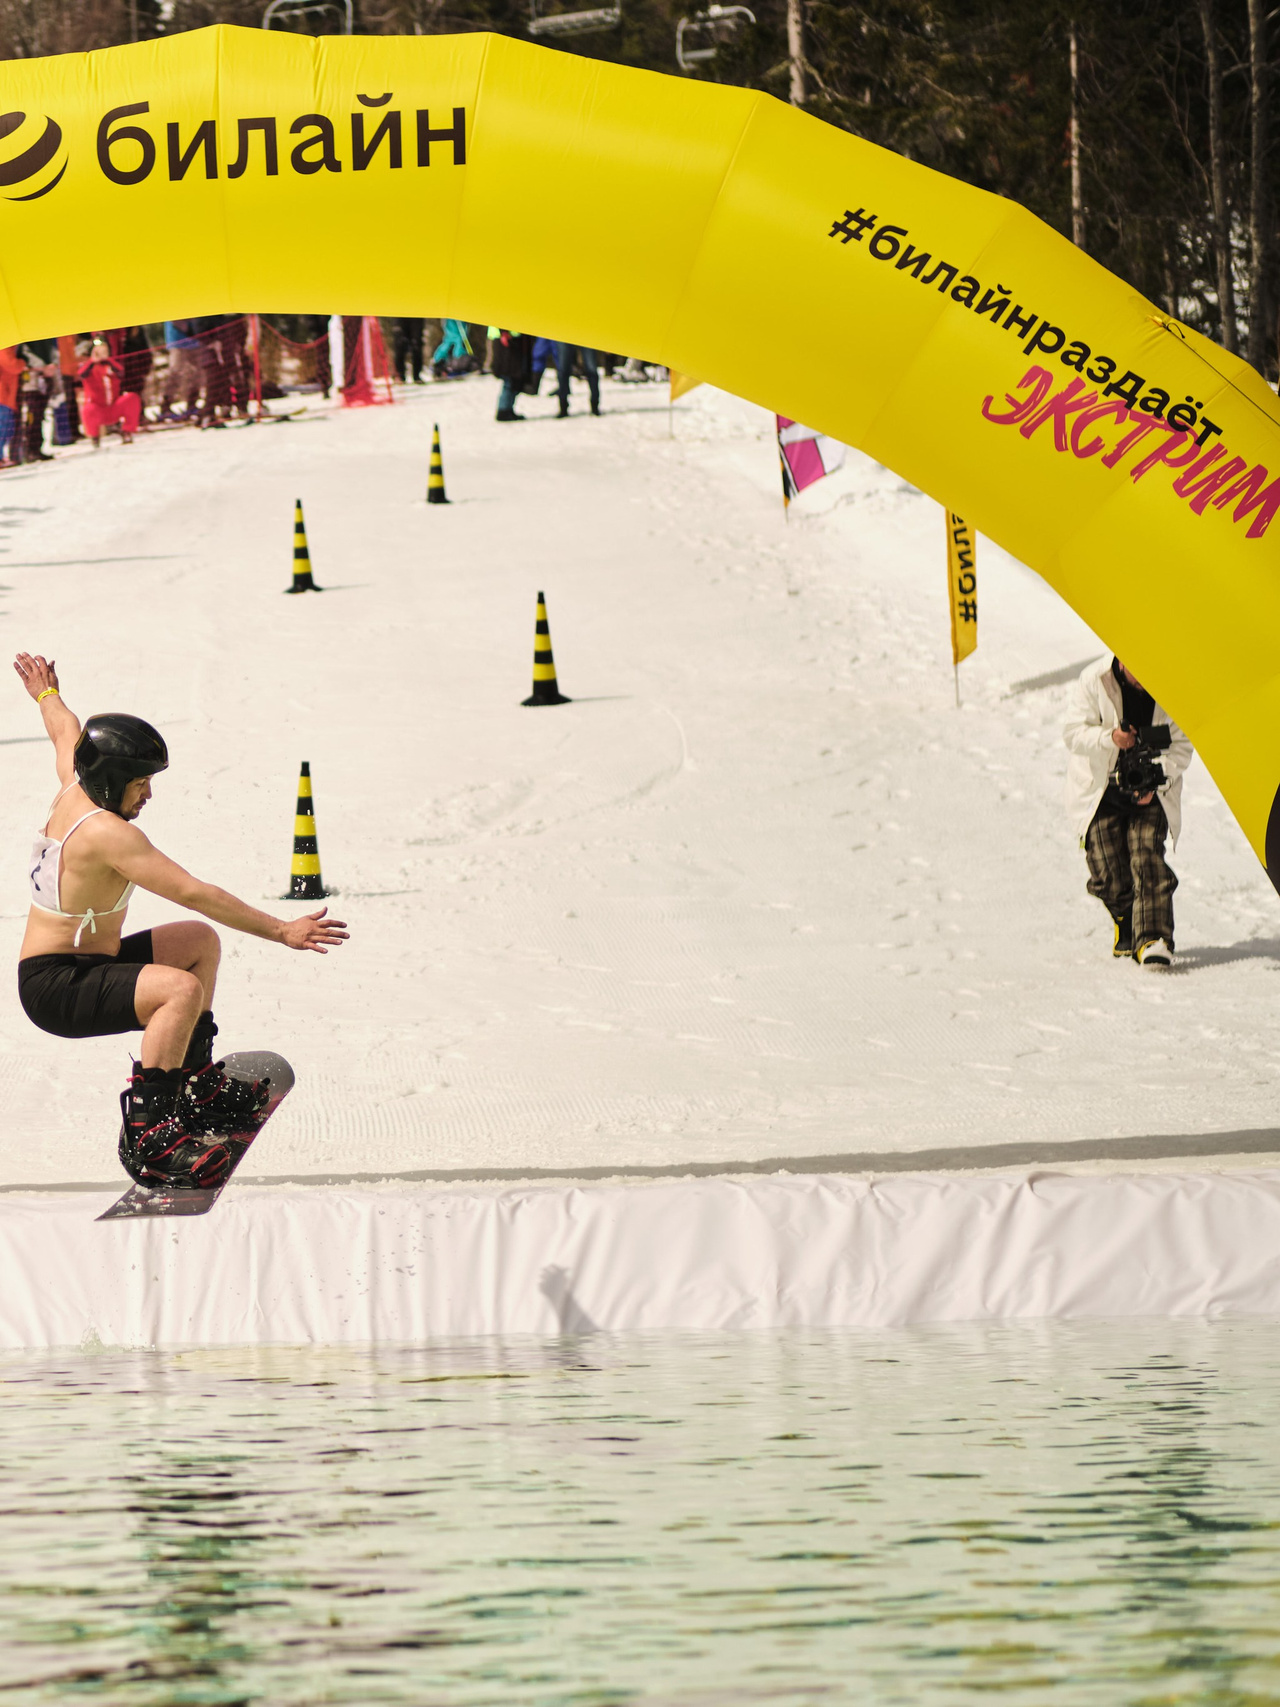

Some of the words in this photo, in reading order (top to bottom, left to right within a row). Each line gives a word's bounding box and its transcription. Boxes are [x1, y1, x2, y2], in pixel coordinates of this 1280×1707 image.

[96, 93, 466, 186] билайн
[828, 208, 1223, 447] #билайнраздаёт
[982, 365, 1280, 538] ЭКСТРИМ
